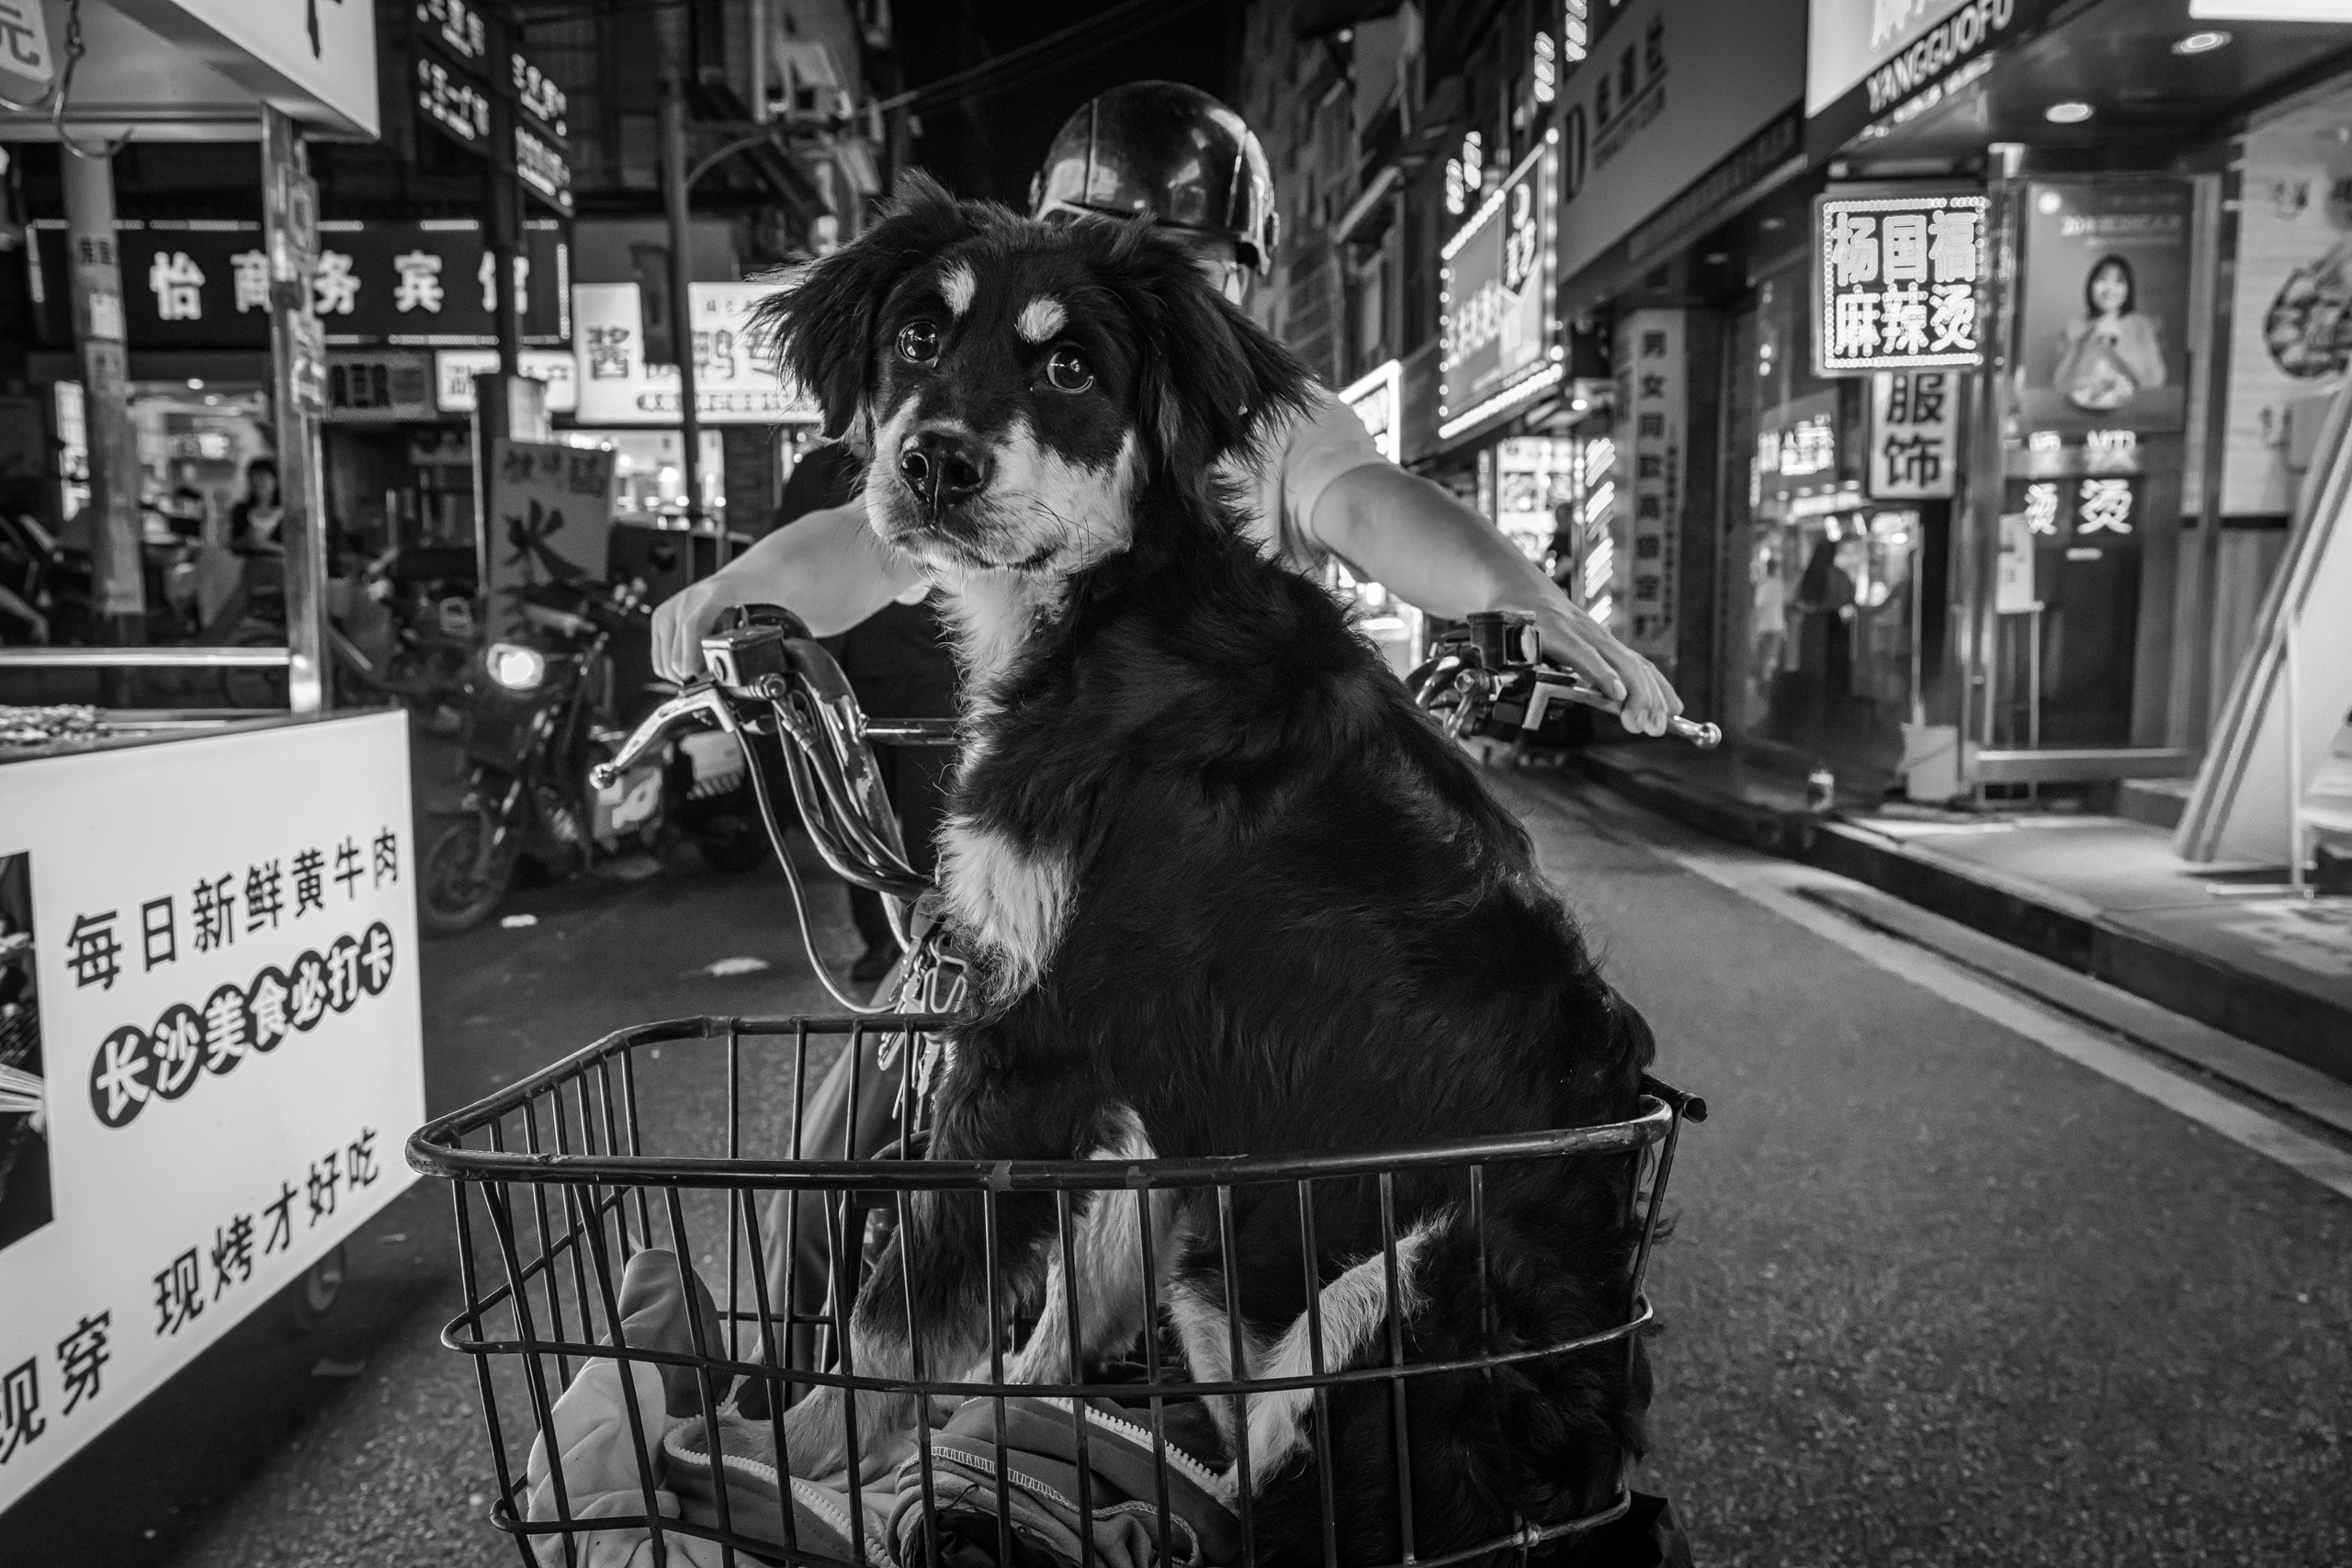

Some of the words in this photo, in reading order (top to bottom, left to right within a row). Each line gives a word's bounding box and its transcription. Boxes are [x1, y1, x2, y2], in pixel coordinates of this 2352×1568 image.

[1832, 211, 1977, 286] 杨国福
[1835, 284, 1977, 356] 麻辣烫
[1884, 374, 1944, 489] 服饰
[65, 825, 398, 990] 每日新鲜黄牛肉
[95, 926, 393, 1121] 长沙美食必打卡
[153, 1128, 379, 1336] 现烤才好吃
